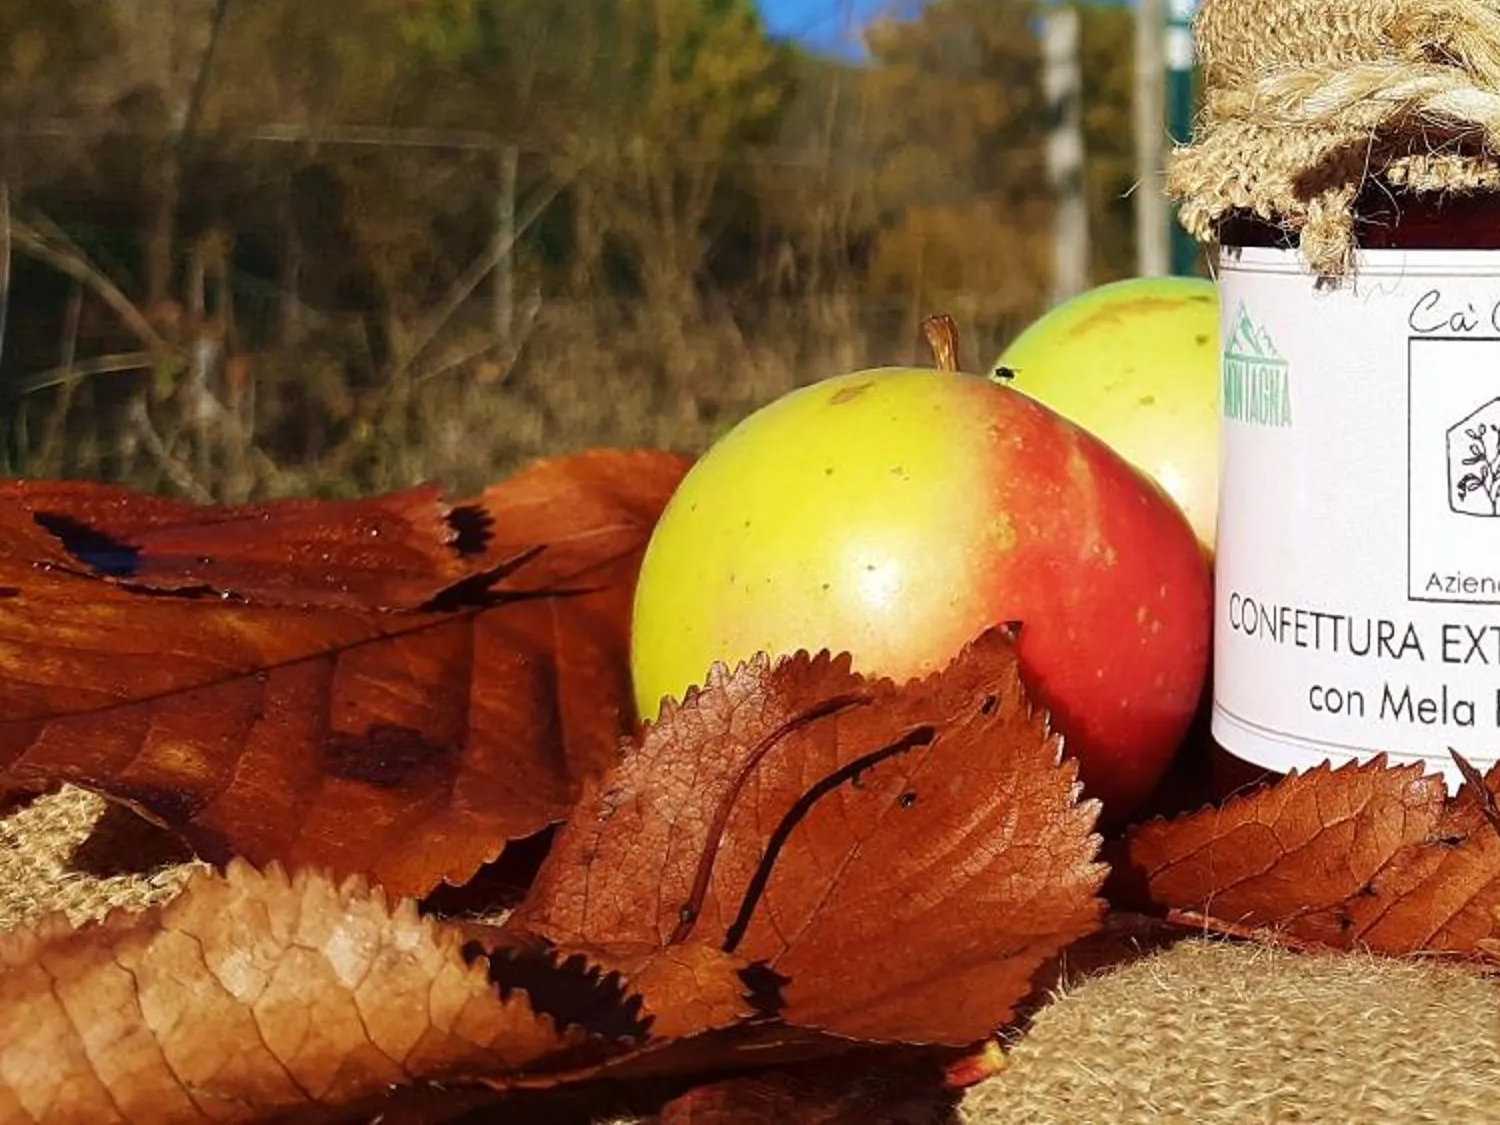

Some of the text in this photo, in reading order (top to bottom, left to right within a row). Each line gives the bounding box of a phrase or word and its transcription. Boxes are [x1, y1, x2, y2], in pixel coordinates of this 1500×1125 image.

[1229, 592, 1424, 661] CONFETTURA
[1309, 683, 1365, 718] con
[1379, 683, 1476, 728] Mela
